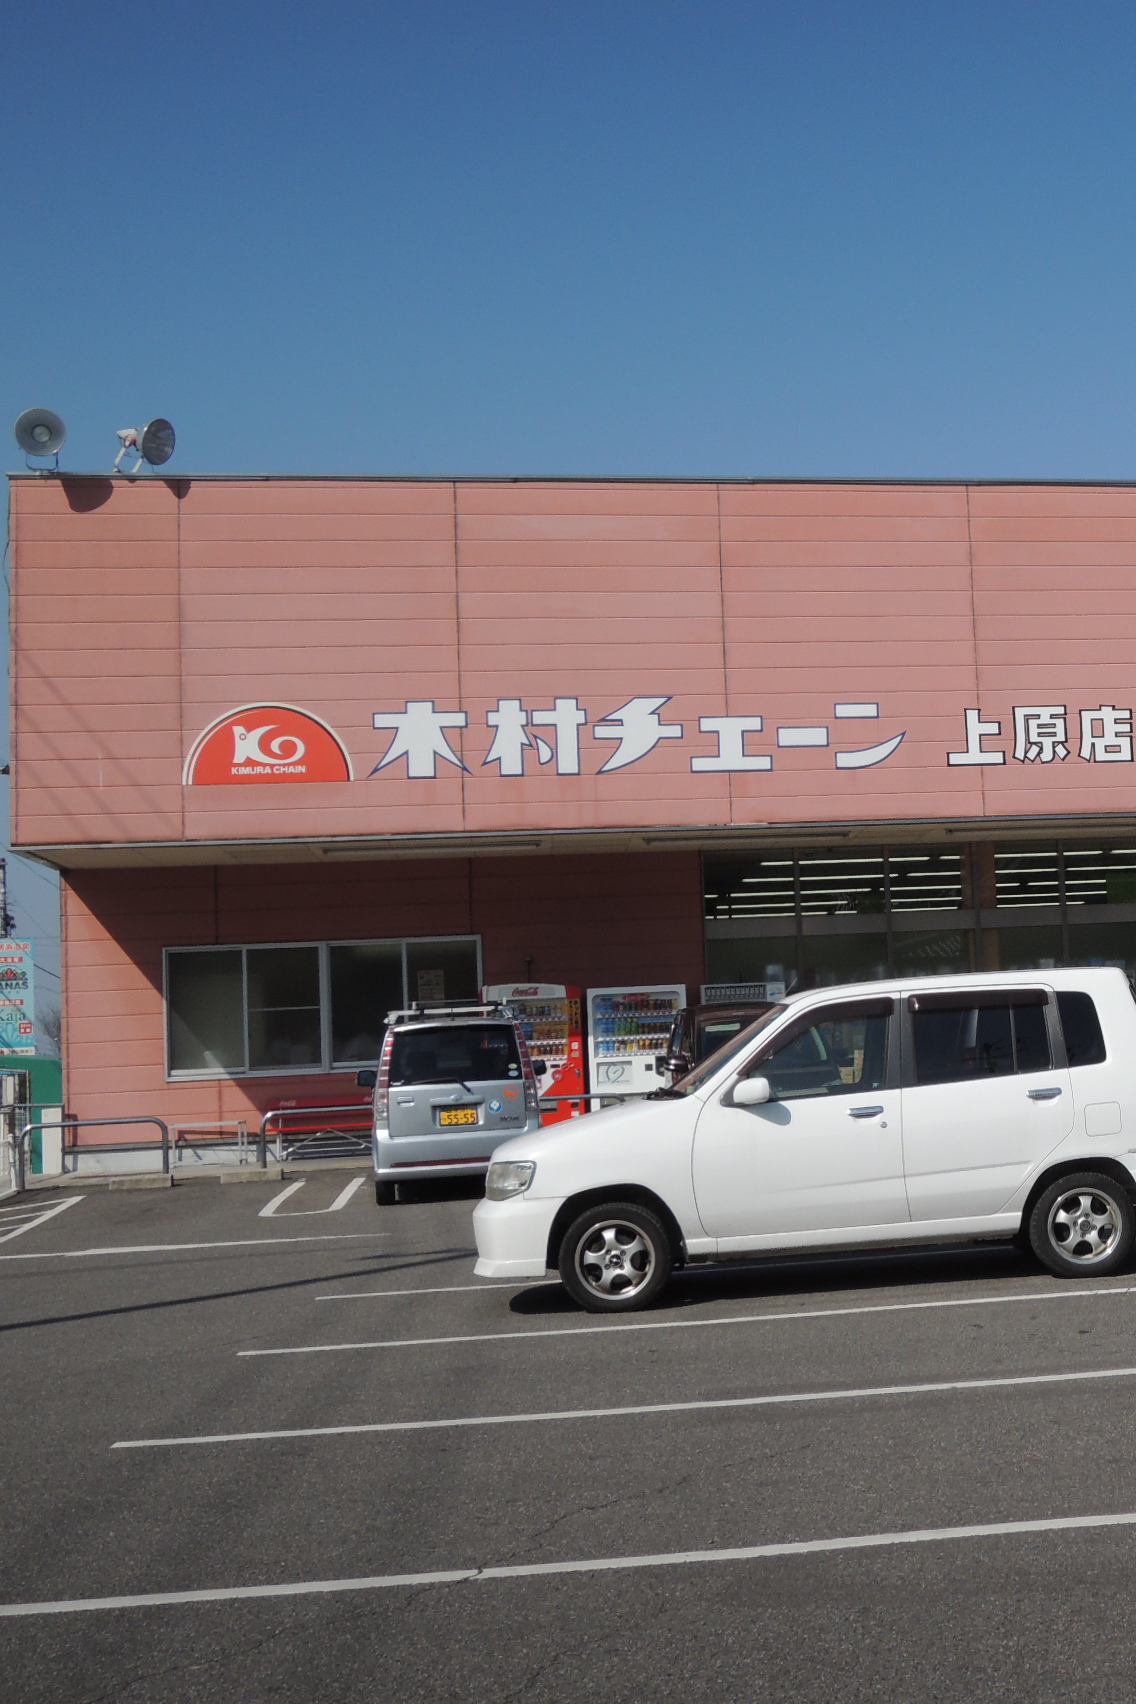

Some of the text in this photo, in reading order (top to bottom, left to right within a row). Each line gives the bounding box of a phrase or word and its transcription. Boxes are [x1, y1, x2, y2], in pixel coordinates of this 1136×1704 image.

[368, 697, 1134, 778] 木村チェーン 上原店
[231, 764, 306, 775] KIMURA CHAIN
